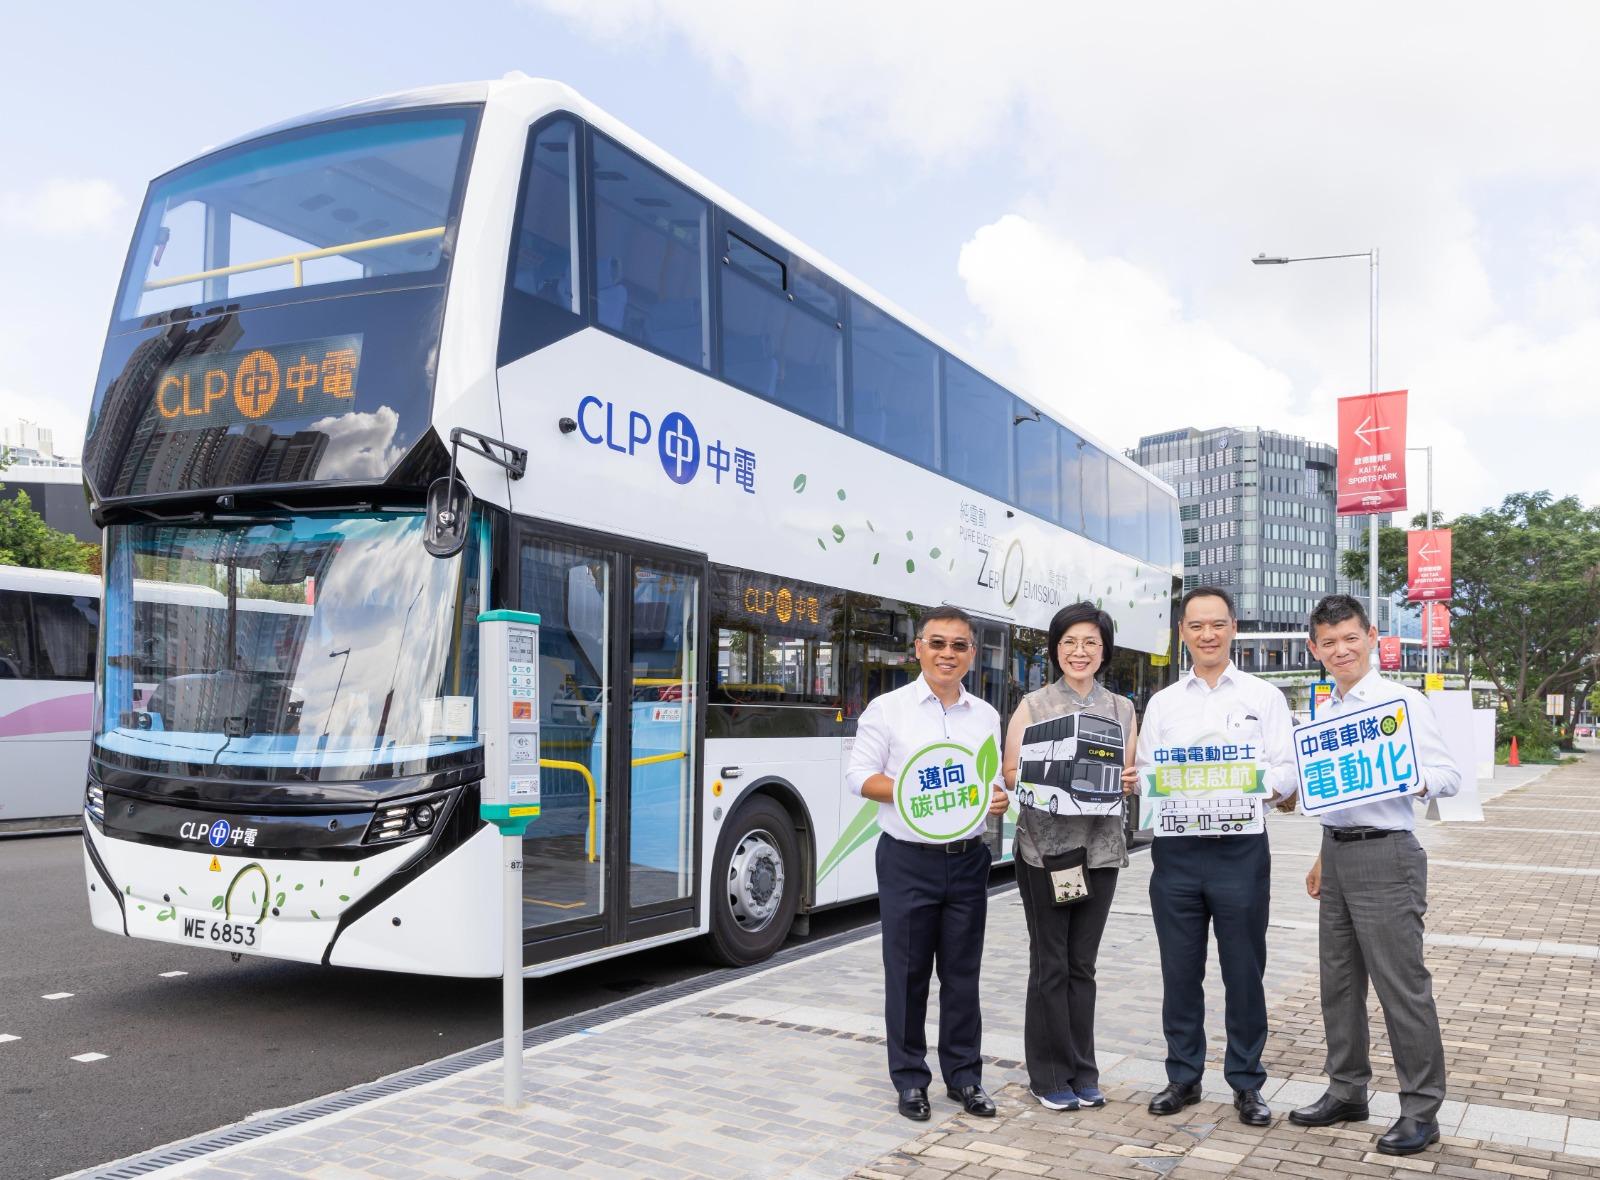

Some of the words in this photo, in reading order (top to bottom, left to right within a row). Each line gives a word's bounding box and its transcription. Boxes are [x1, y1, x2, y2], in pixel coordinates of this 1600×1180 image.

[156, 368, 229, 419] CLP
[286, 348, 357, 402] 中電
[577, 395, 651, 456] CLP
[706, 439, 756, 494] 中電
[1348, 475, 1377, 485] SPORTS
[1378, 472, 1397, 481] PARK
[1359, 466, 1371, 474] KAI
[1373, 464, 1387, 472] TAK
[744, 587, 775, 615] CLP
[1024, 580, 1061, 607] EMISSION
[1301, 716, 1381, 757] 中電車隊
[1154, 744, 1256, 763] 中電電動巴士
[918, 764, 965, 791] 邁向
[1304, 741, 1412, 799] 電動化
[910, 784, 980, 818] 碳中和
[180, 822, 209, 840] CLP
[230, 827, 258, 847] 中電
[184, 917, 206, 939] WE
[210, 921, 257, 946] 6853
